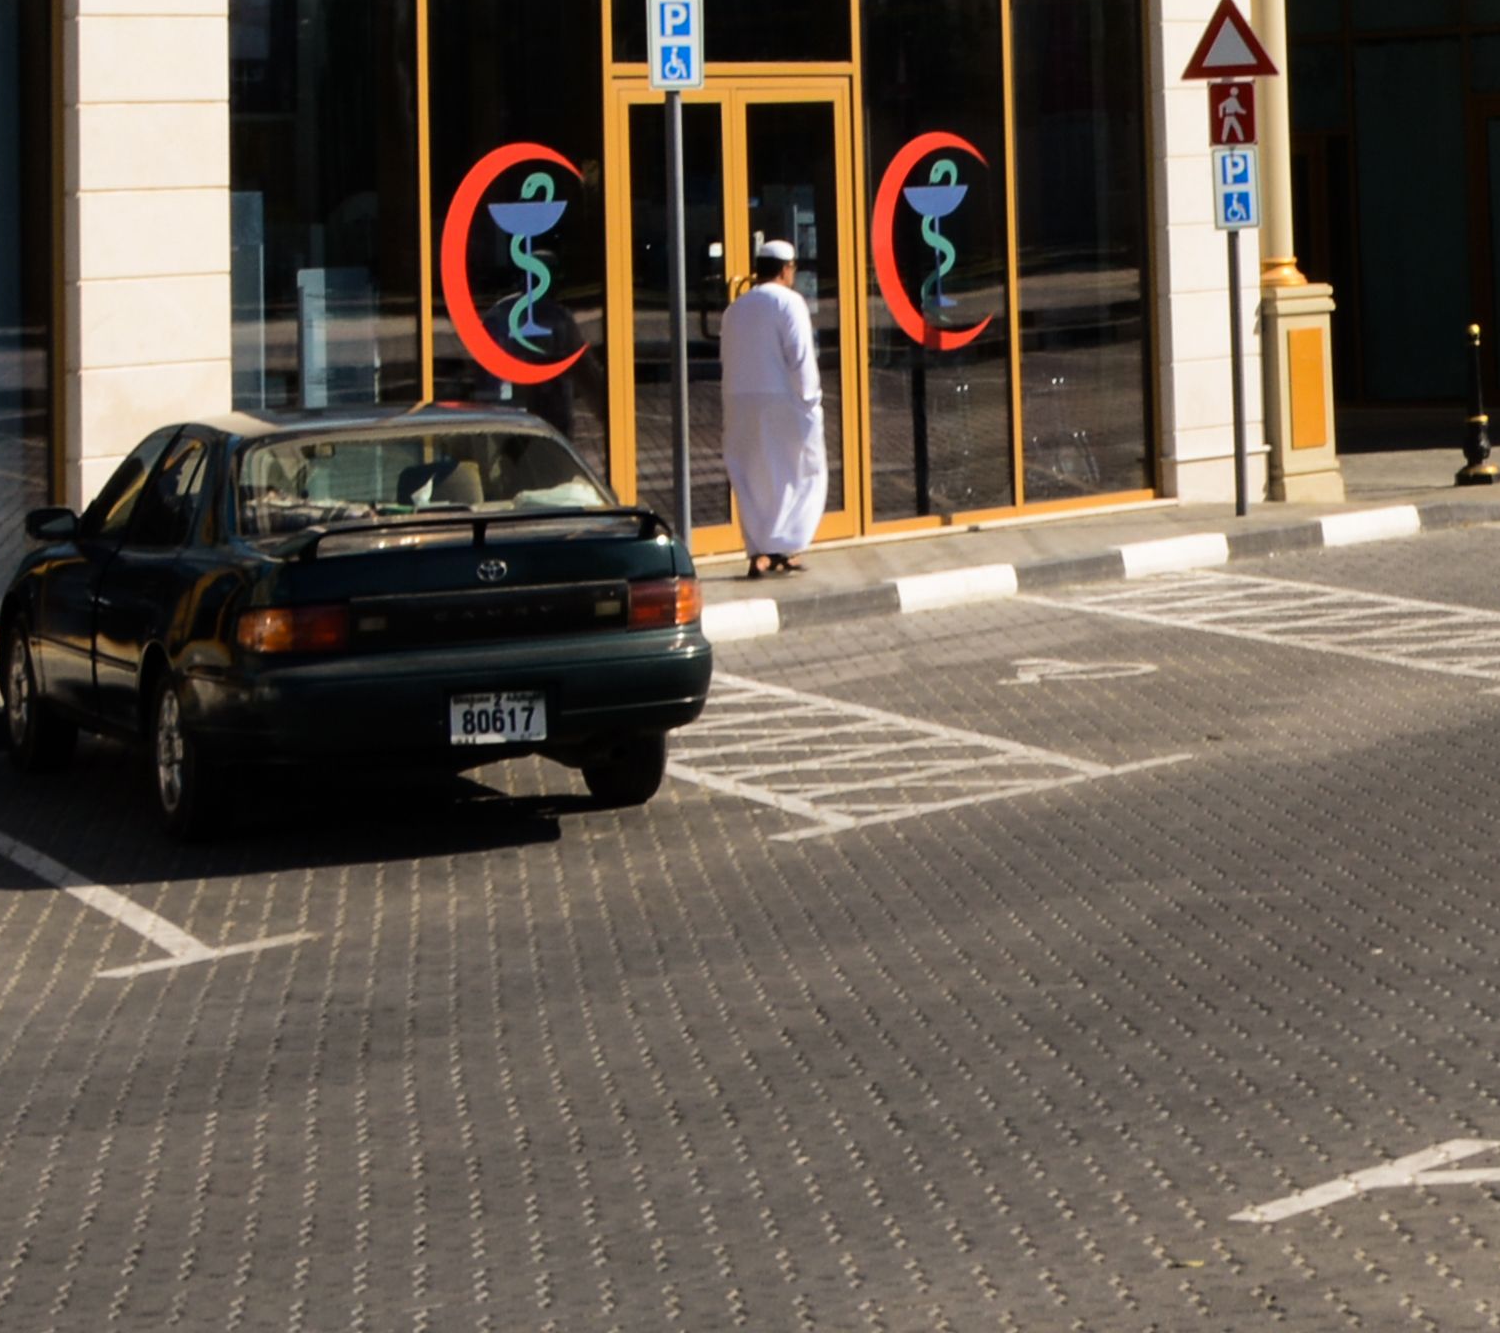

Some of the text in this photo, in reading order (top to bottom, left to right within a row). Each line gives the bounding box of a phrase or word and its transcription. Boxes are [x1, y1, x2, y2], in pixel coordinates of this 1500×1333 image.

[663, 3, 688, 37] P
[1225, 154, 1245, 185] P
[462, 705, 535, 735] 80617
